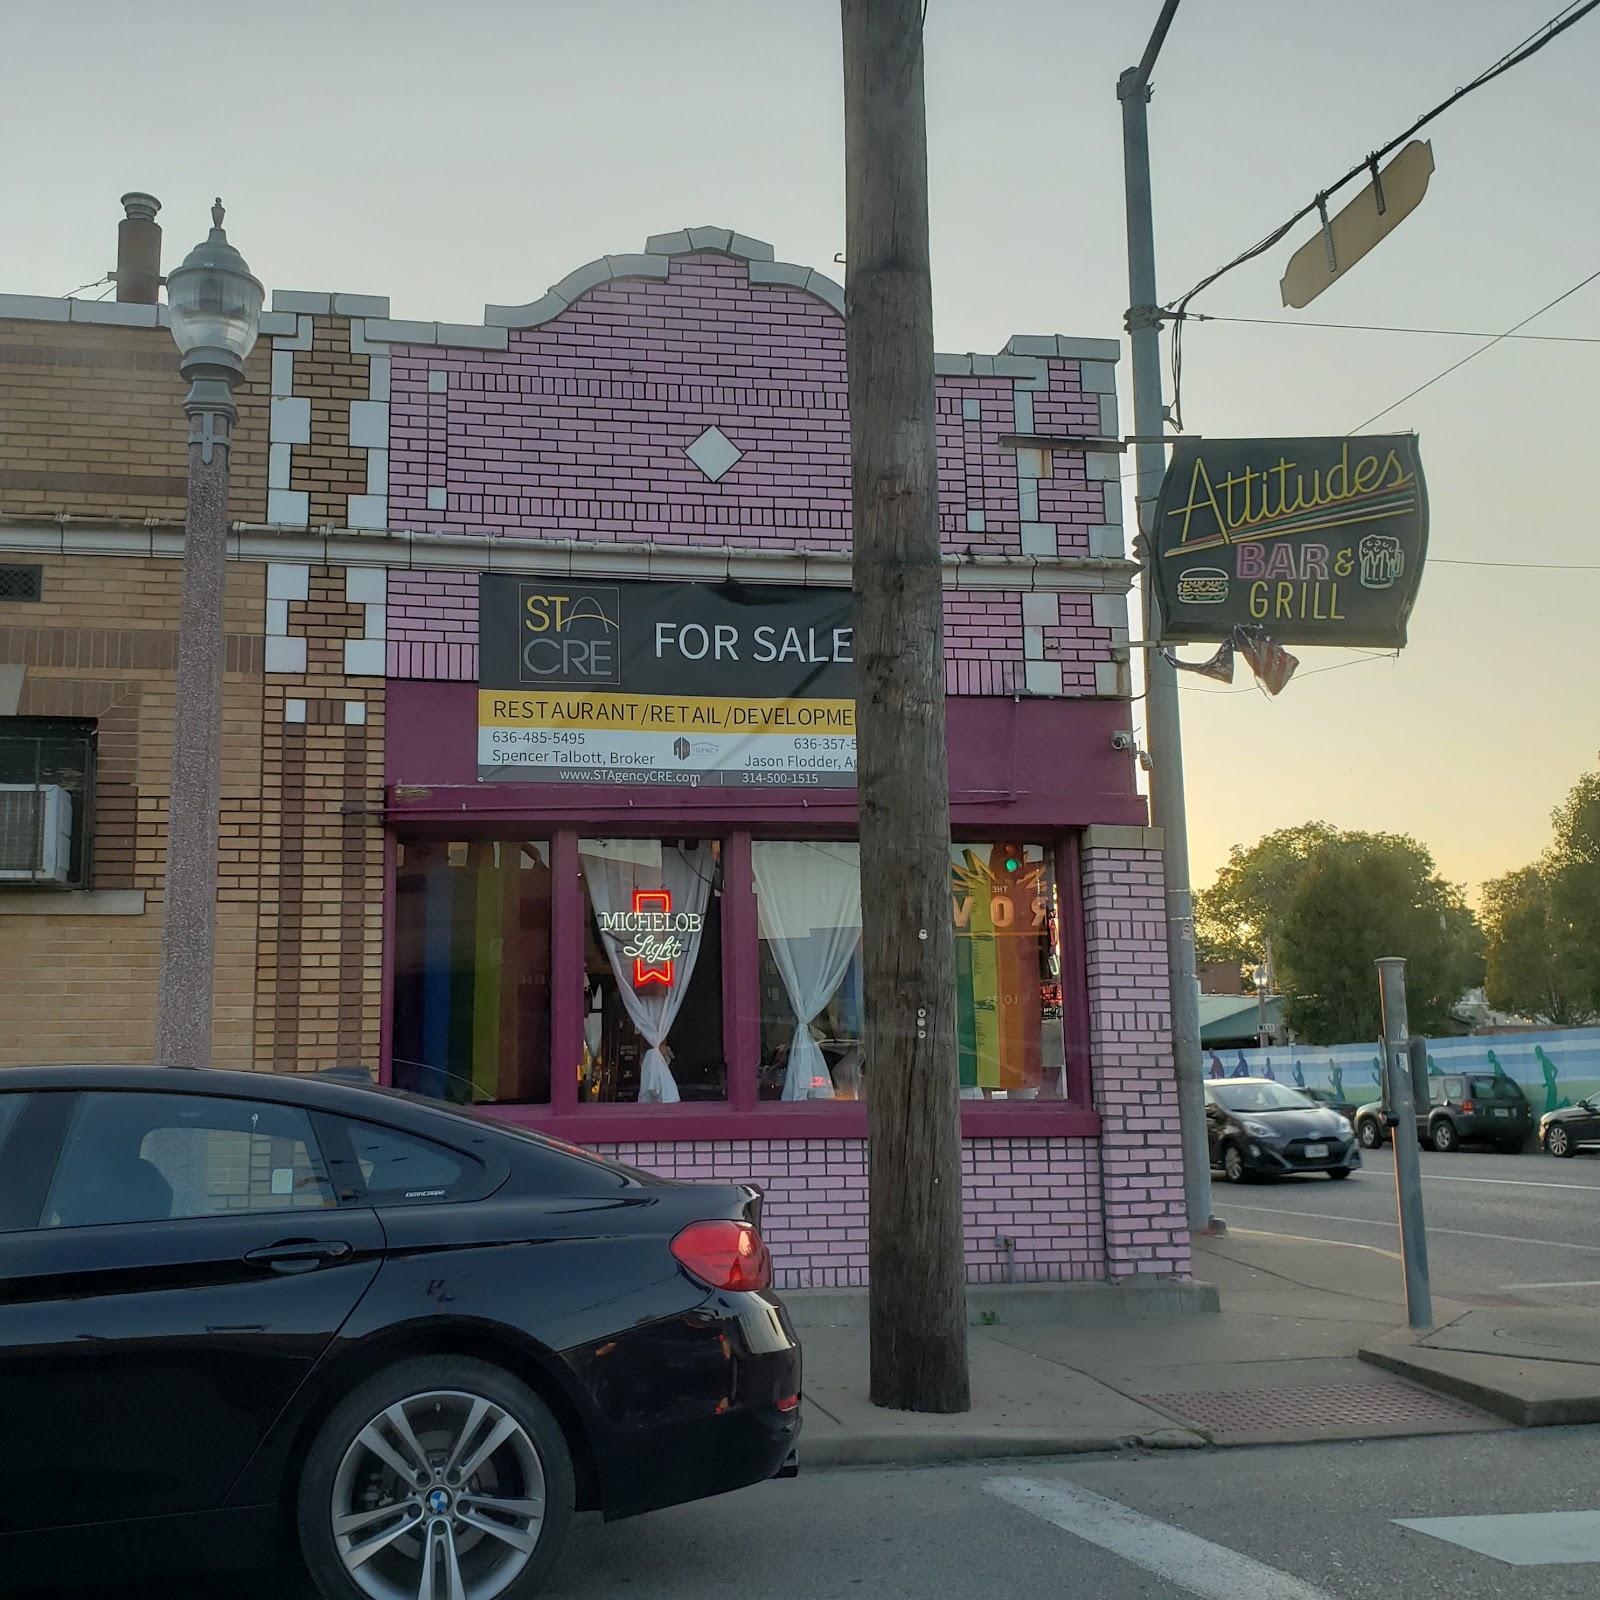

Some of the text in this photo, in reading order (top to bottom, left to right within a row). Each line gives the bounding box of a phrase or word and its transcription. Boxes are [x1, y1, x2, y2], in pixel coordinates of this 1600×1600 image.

[1167, 442, 1415, 545] Attitudes
[1236, 543, 1355, 581] BAR &
[1250, 580, 1346, 620] GRILL
[655, 621, 854, 663] FOR SALE
[523, 637, 613, 677] CRE
[493, 699, 857, 728] RESTAURANT/RETAIL/DEVELOPME
[492, 731, 586, 745] 636-485-5495
[492, 749, 656, 766] Spencer Talbott, Broker
[744, 754, 783, 768] Jason
[787, 754, 842, 770] Flodder,
[559, 769, 701, 784] www.STAgencyCRE.com
[742, 772, 819, 785] 314-500-1515
[600, 911, 702, 933] MICHELOB
[622, 932, 683, 964] Light
